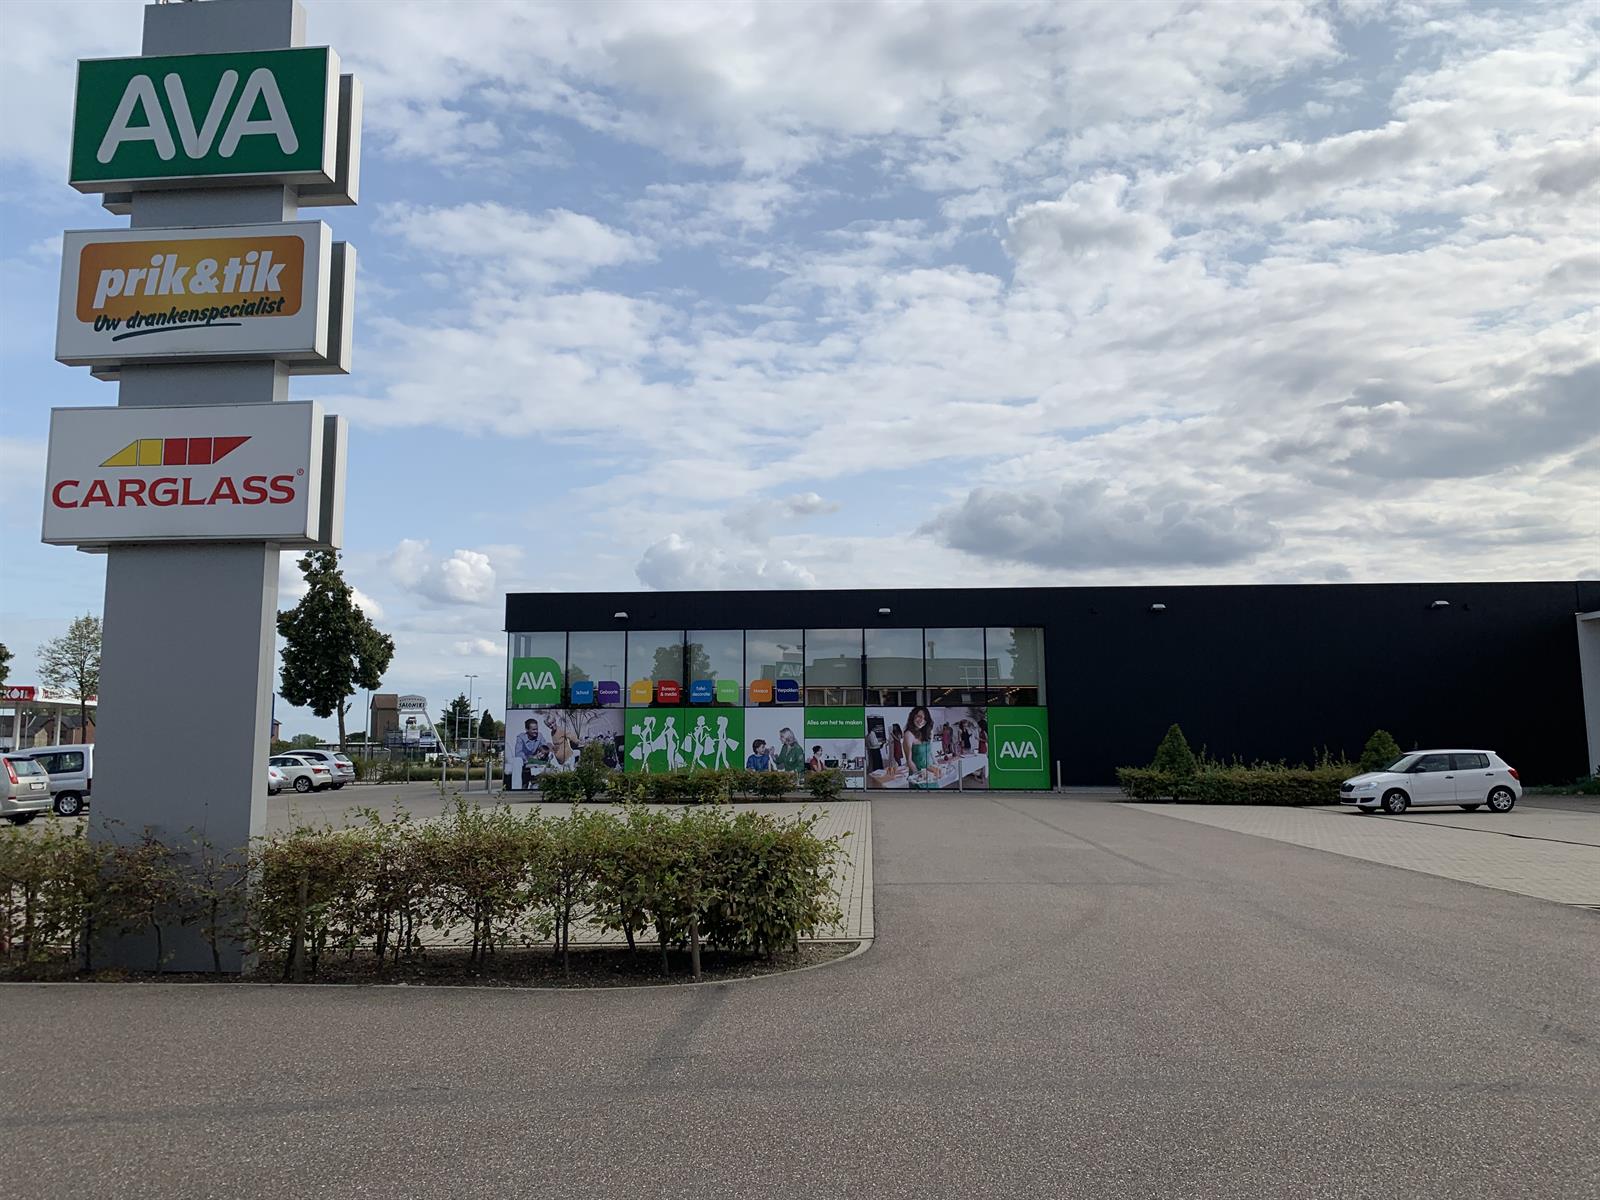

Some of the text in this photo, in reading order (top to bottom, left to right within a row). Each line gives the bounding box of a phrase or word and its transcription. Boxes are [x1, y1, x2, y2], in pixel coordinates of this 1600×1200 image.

[97, 68, 299, 164] AVA
[93, 251, 286, 309] prik&tik
[94, 297, 285, 332] Uw drankenspecialist
[52, 475, 295, 508] CARGLASS
[516, 671, 557, 690] AVA
[1000, 741, 1038, 758] AVA
